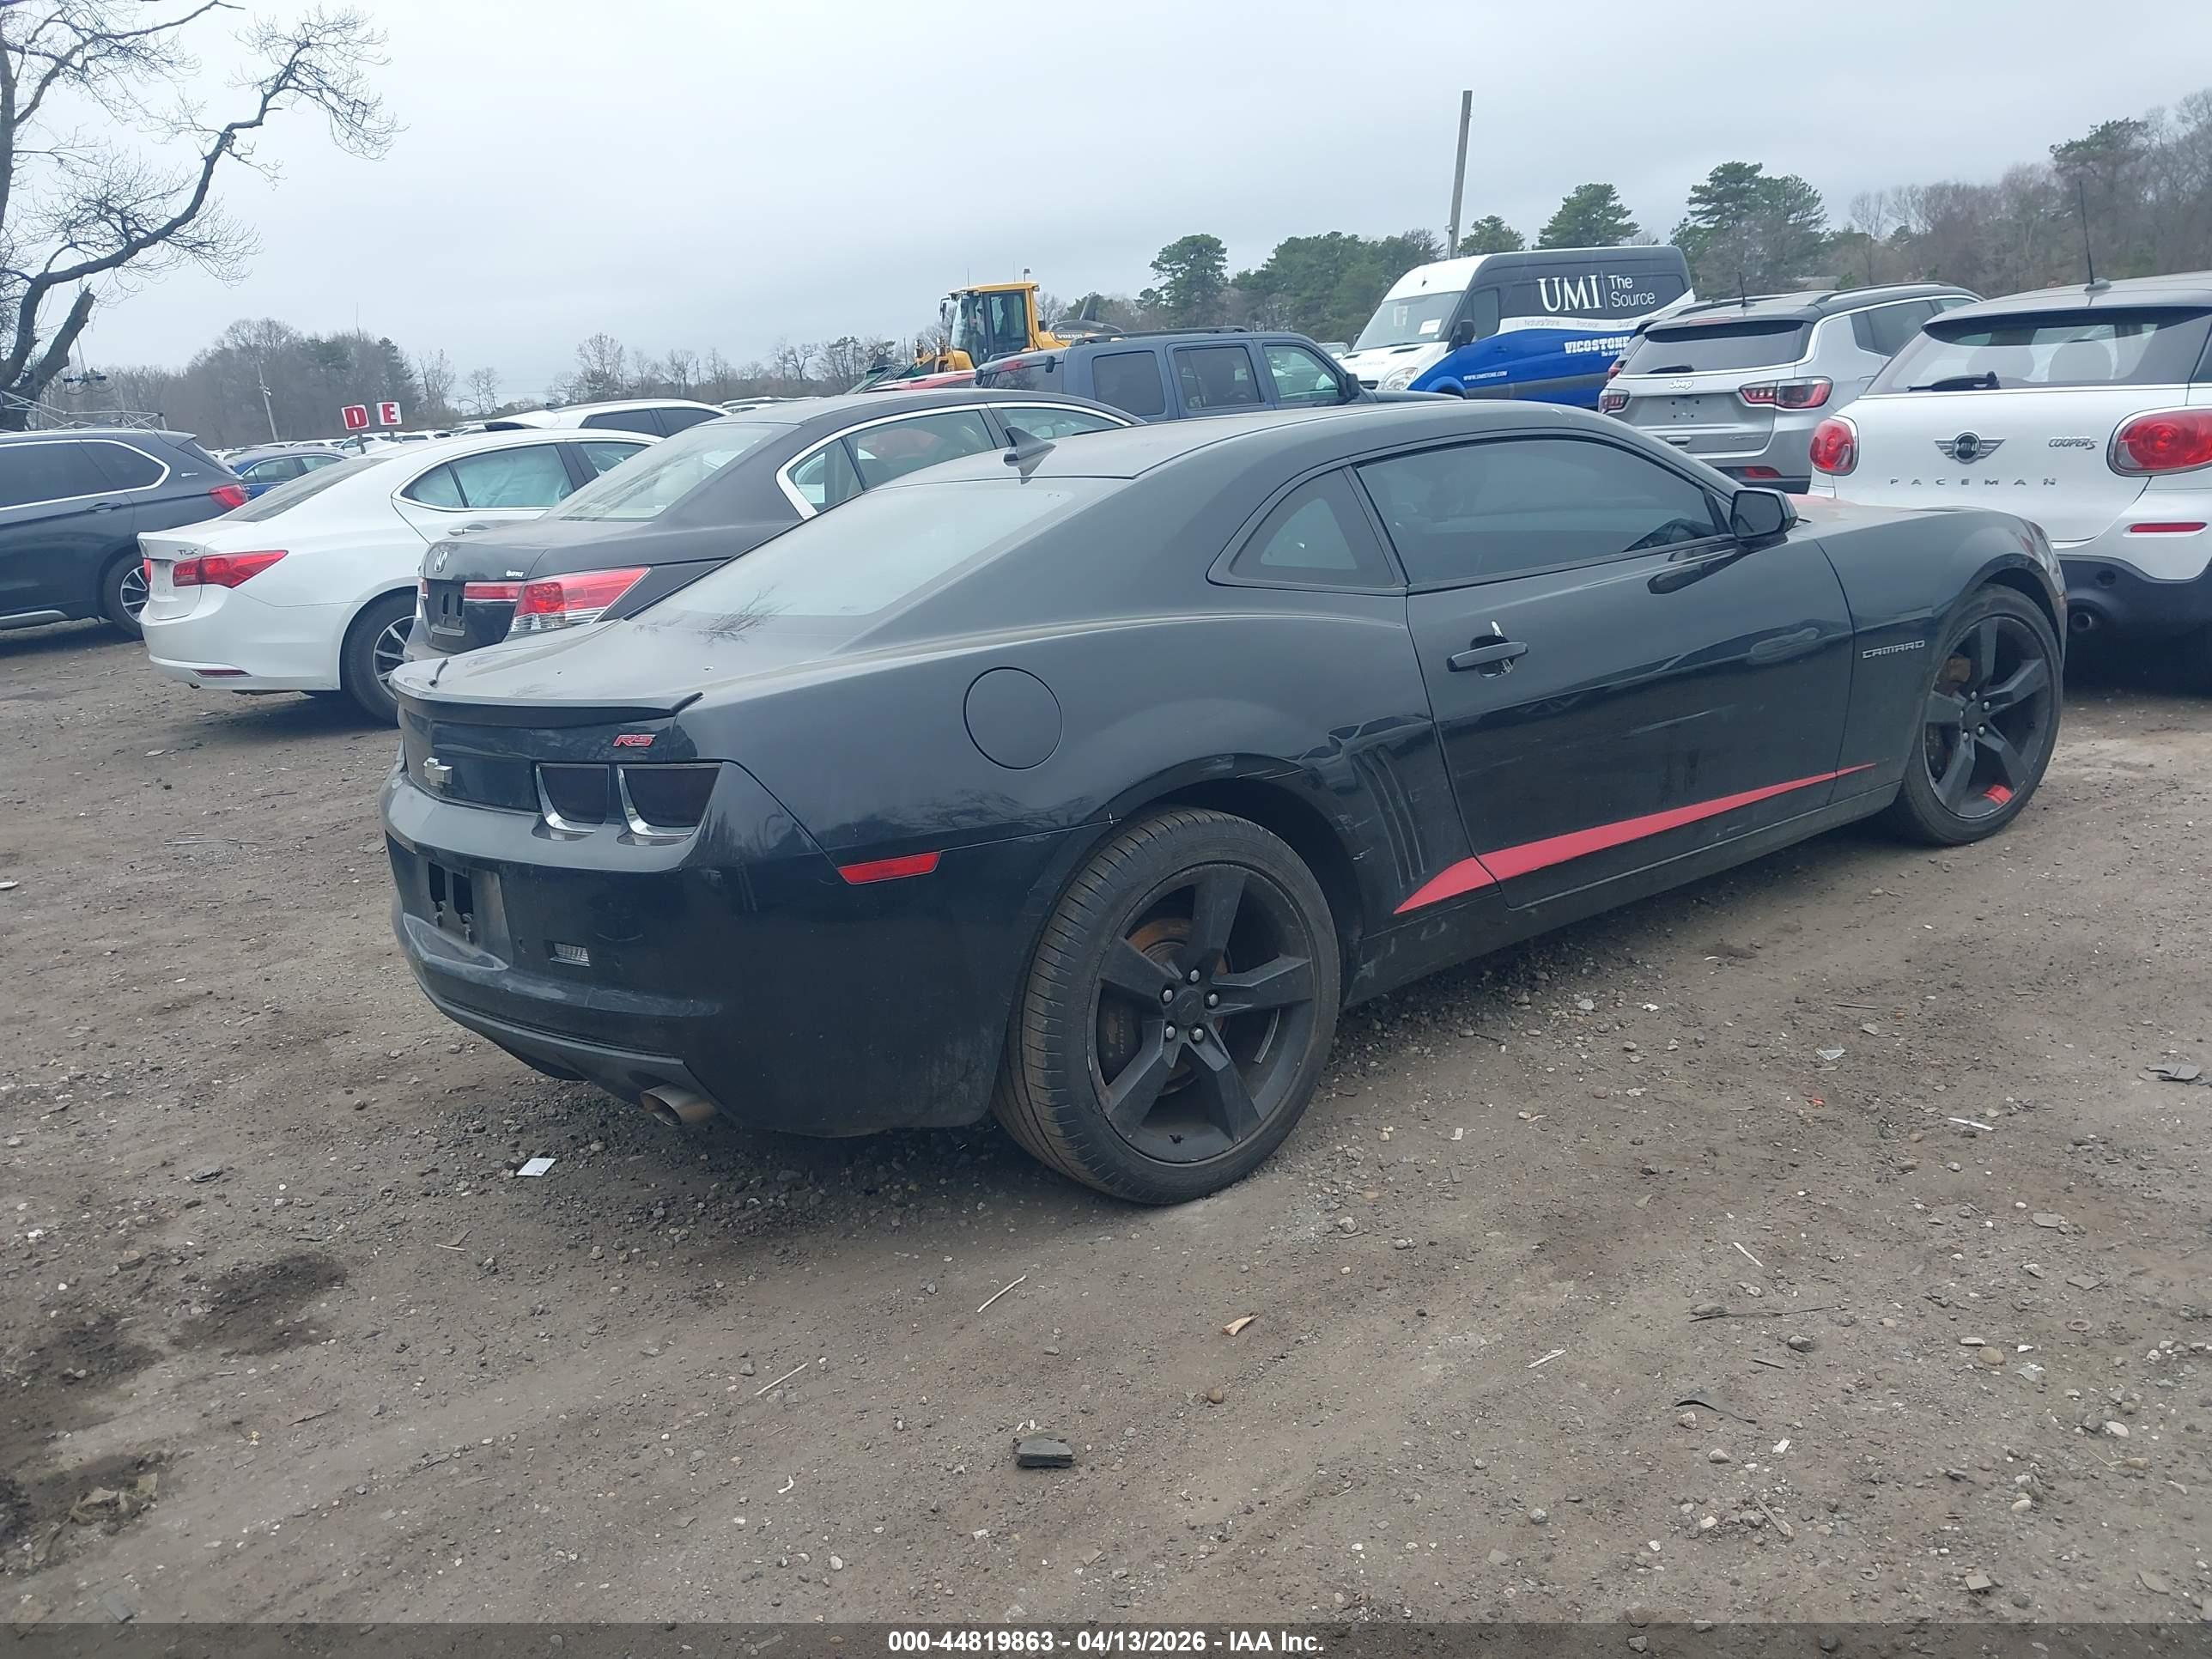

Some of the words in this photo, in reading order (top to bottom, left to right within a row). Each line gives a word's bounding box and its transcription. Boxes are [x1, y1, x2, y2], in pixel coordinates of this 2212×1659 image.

[1607, 275, 1633, 289] The
[1537, 275, 1602, 312] UMI
[1611, 292, 1656, 308] Source
[1564, 336, 1631, 355] VICOSTONE
[1669, 379, 1694, 389] Jeep
[344, 407, 368, 428] D
[382, 404, 398, 423] E
[1862, 640, 1925, 659] CAMARO
[613, 734, 656, 747] RS
